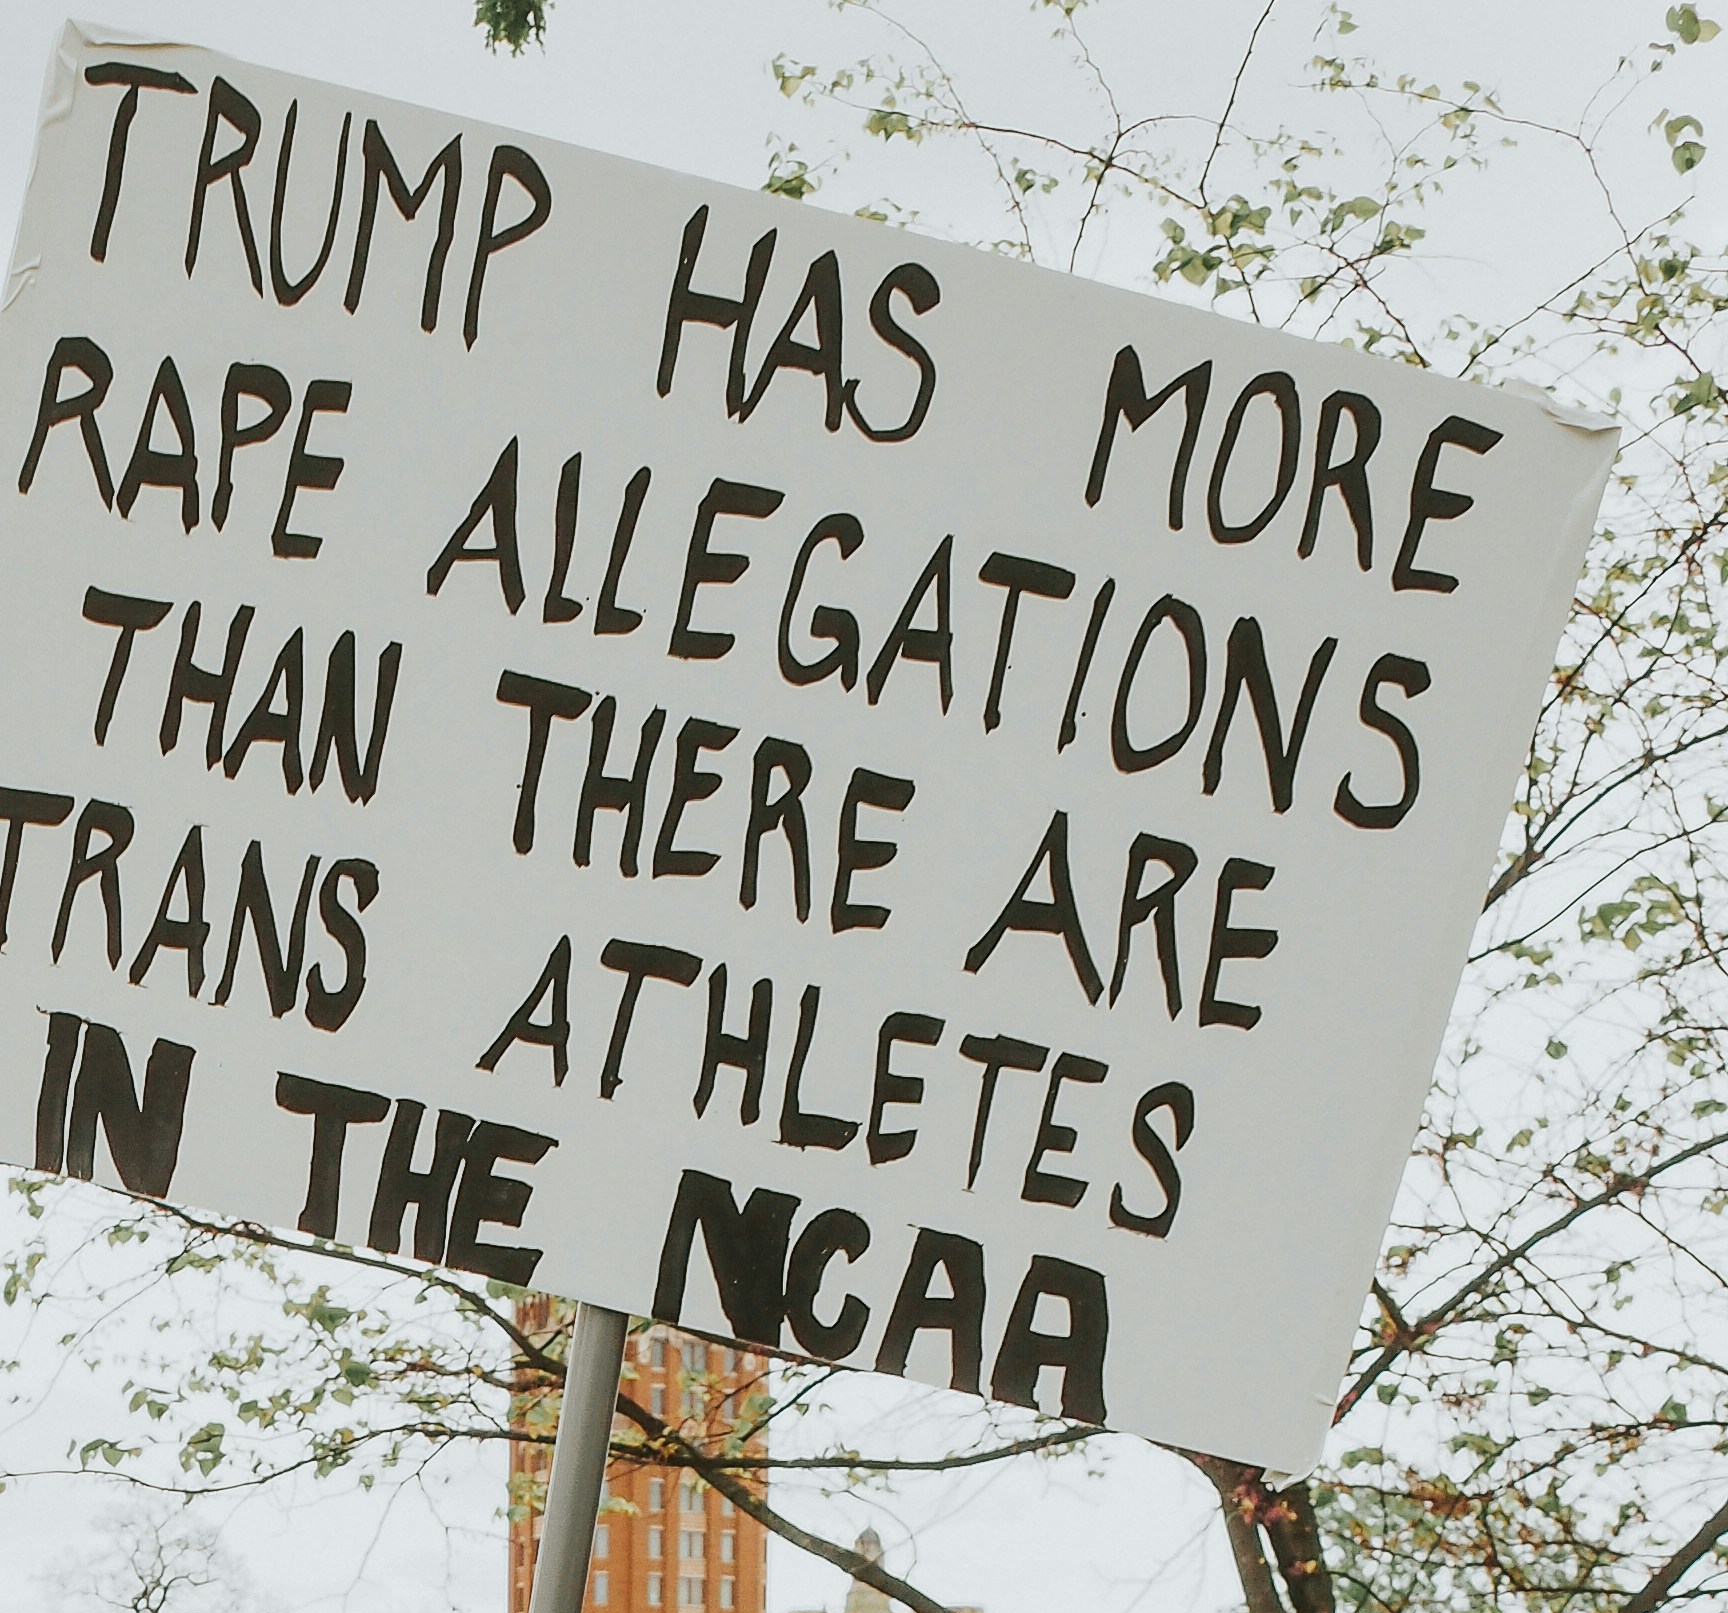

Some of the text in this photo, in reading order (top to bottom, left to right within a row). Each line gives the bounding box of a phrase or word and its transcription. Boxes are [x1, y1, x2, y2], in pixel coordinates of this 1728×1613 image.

[84, 62, 1504, 593] TRUMP HAS MORE
[18, 337, 1431, 829] RAPE ALLEGATIONS
[82, 586, 1278, 1030] THAN THERE ARE
[34, 1008, 1107, 1424] IN THE NCAA
[475, 935, 1194, 1239] ATHLETES
